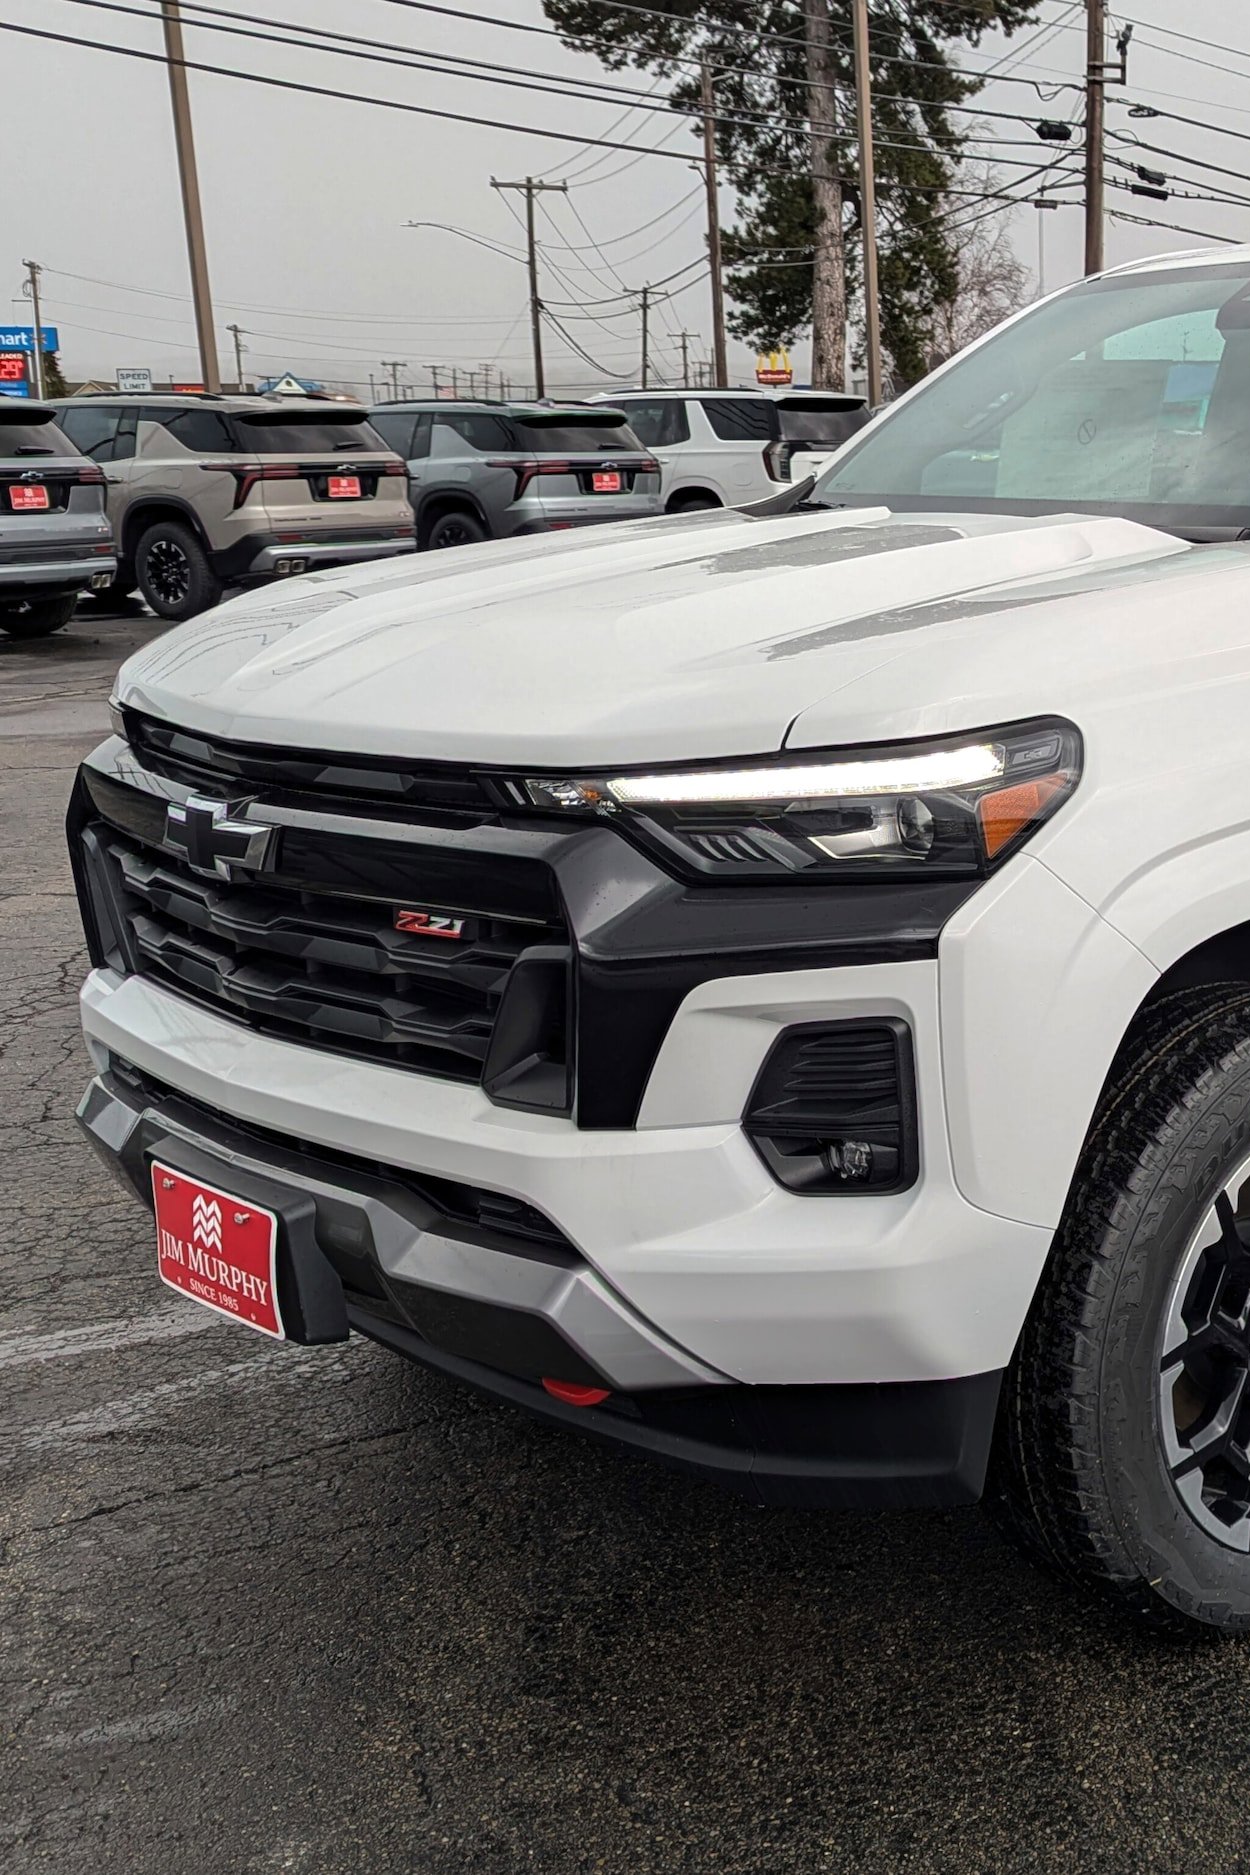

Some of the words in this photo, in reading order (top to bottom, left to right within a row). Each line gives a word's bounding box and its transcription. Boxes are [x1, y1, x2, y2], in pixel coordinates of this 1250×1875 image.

[395, 910, 465, 939] Z71
[161, 1229, 184, 1265] JIM
[187, 1242, 268, 1306] MURPHY
[190, 1278, 217, 1302] SINCE
[218, 1291, 240, 1312] 1985
